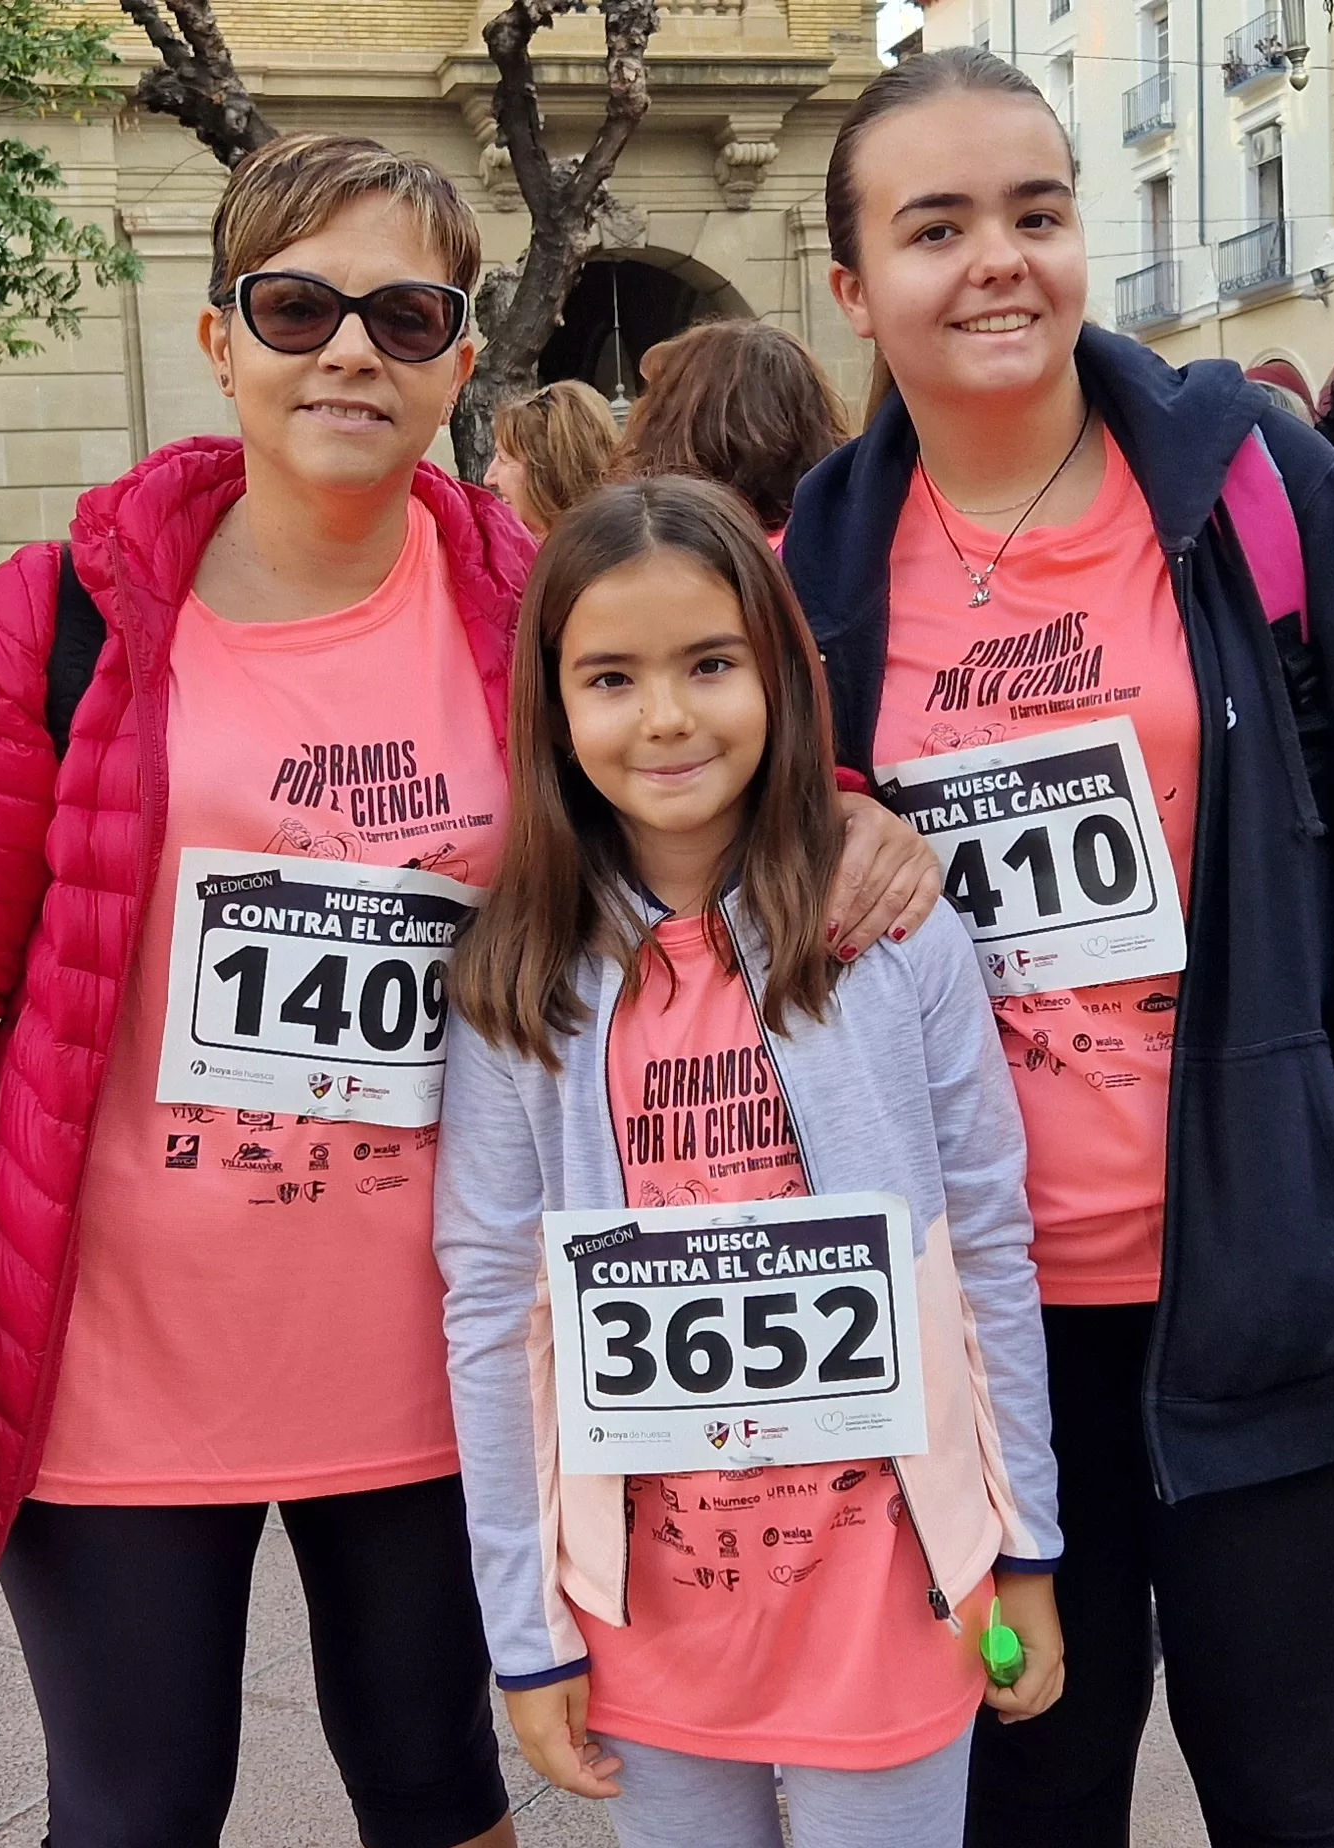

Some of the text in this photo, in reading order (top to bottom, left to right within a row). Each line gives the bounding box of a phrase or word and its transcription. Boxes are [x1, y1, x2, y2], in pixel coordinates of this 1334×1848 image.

[959, 611, 1089, 669] CORRAMOS
[925, 644, 1104, 712] POR LA CIENCIA
[1018, 703, 1048, 719] Carrera
[1048, 697, 1075, 714] Huesca
[1076, 693, 1102, 708] contra
[1104, 689, 1112, 703] el
[351, 773, 451, 828] CIENCIA
[899, 773, 1115, 833] NTRA EL CÁNCER
[943, 770, 1024, 801] HUESCA
[367, 830, 400, 843] Carrera
[400, 824, 430, 839] Huesca
[431, 819, 458, 833] contra
[459, 815, 467, 829] el
[204, 874, 274, 896] XI EDICIÓN
[943, 813, 1138, 929] 410
[324, 891, 406, 917] HUESCA
[221, 902, 458, 944] CONTRA EL CÁNCER
[212, 944, 450, 1053] 1409
[209, 1065, 231, 1076] hoya
[232, 1069, 243, 1077] de
[243, 1070, 275, 1080] huesca
[643, 1044, 769, 1111] CORRAMOS
[626, 1096, 797, 1165] POR LA CIENCIA
[708, 1151, 801, 1179] XI Carrera Huesca contra
[570, 1227, 636, 1258] XI EDICIÓN
[686, 1231, 771, 1254] HUESCA
[591, 1243, 873, 1285] CONTRA EL CÁNCER
[590, 1285, 886, 1397] 3652
[607, 1430, 671, 1440] hoya de huesca
[713, 1495, 761, 1508] Humeco
[766, 1482, 818, 1498] URBAN
